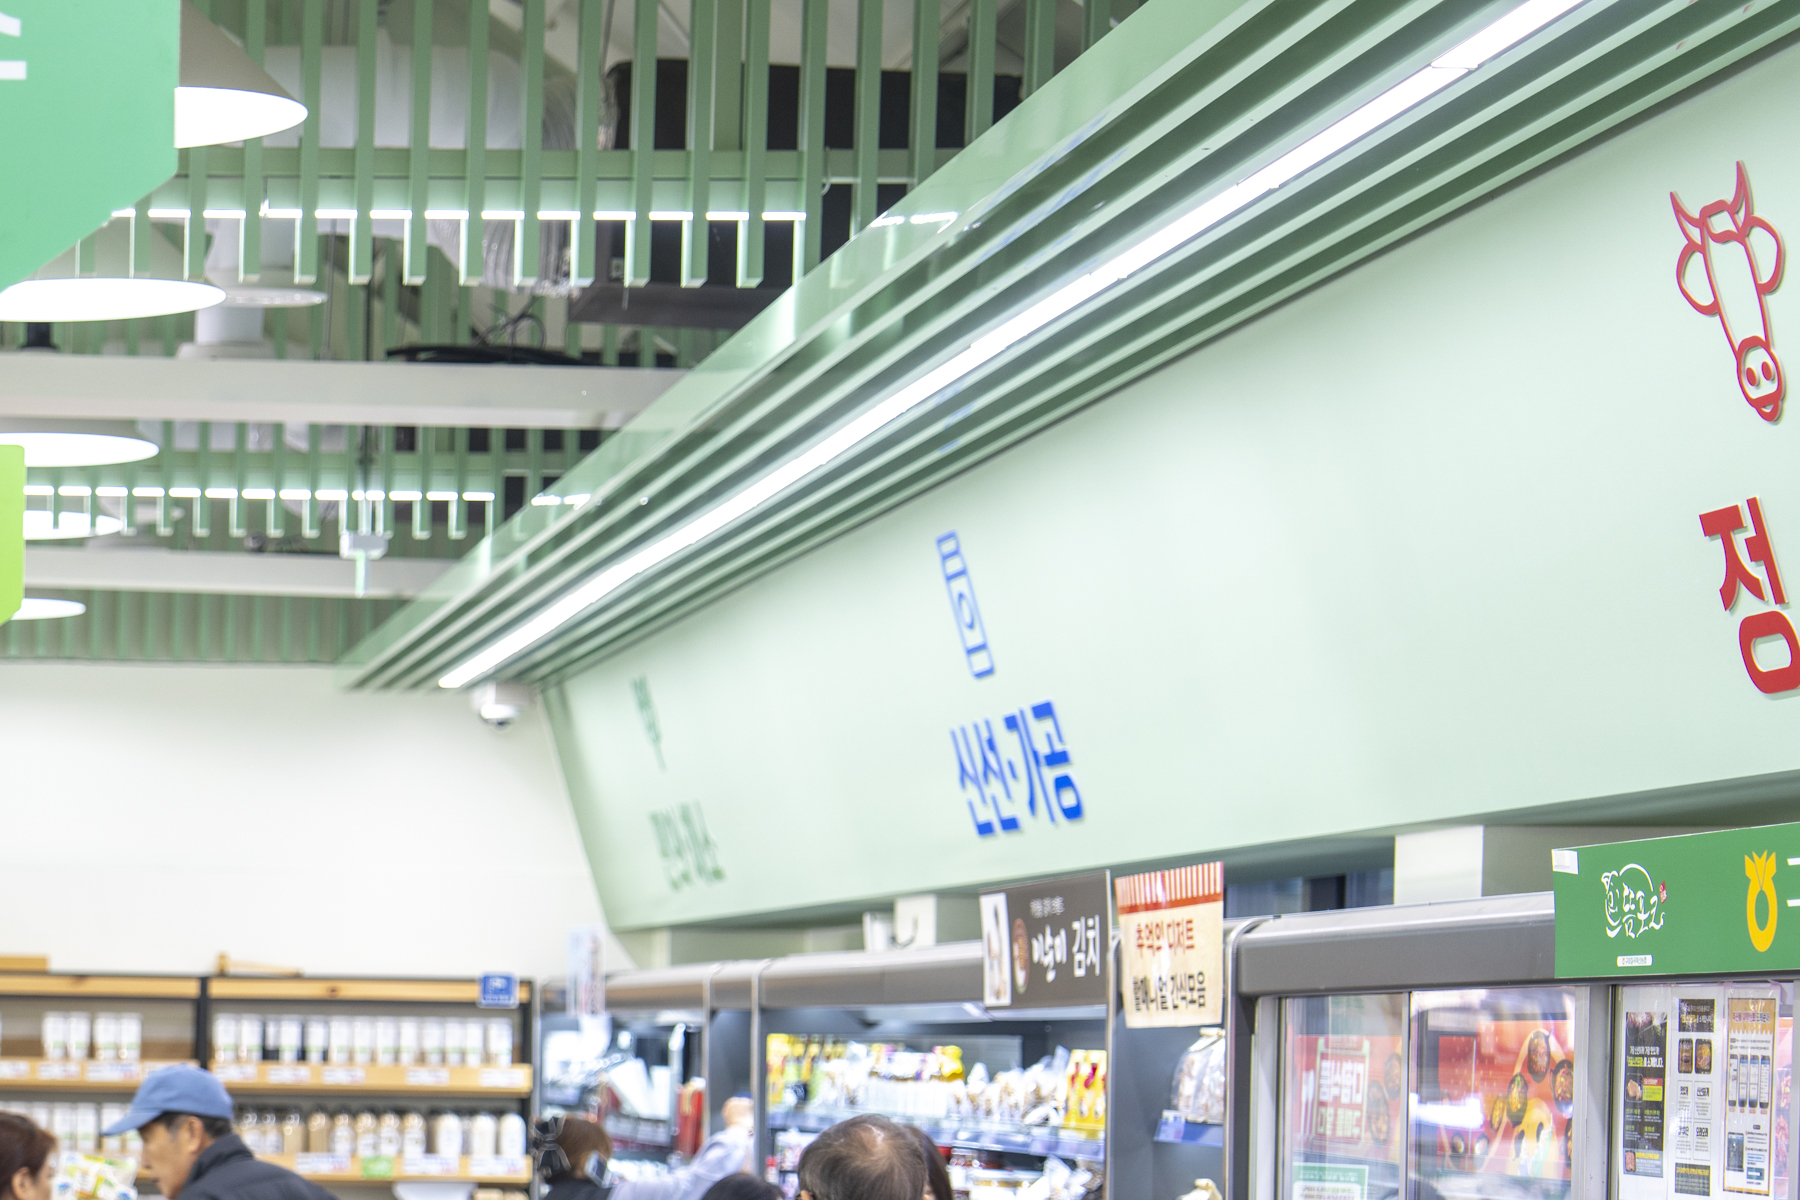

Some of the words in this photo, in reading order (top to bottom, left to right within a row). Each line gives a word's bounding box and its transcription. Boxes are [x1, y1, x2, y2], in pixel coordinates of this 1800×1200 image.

[1072, 914, 1100, 978] 김치
[1167, 918, 1196, 955] 디저트
[1170, 971, 1206, 1010] 간식모음
